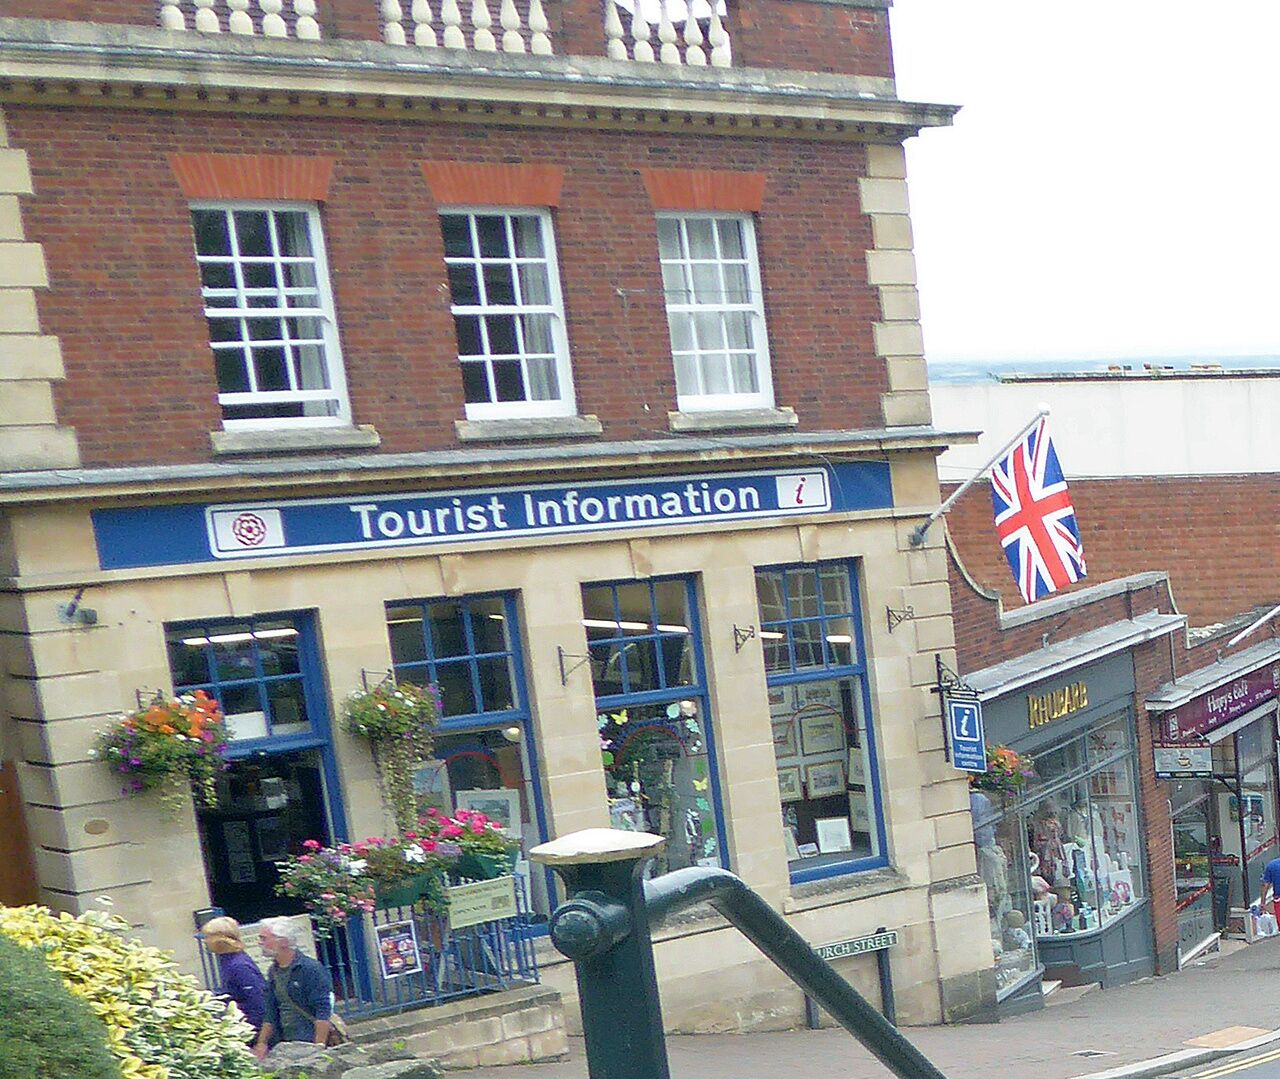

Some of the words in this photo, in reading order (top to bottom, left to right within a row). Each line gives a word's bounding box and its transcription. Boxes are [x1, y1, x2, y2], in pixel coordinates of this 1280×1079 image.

[350, 497, 508, 539] Tourist
[524, 482, 760, 525] Information
[817, 943, 850, 959] URCH
[853, 934, 894, 952] STREET
